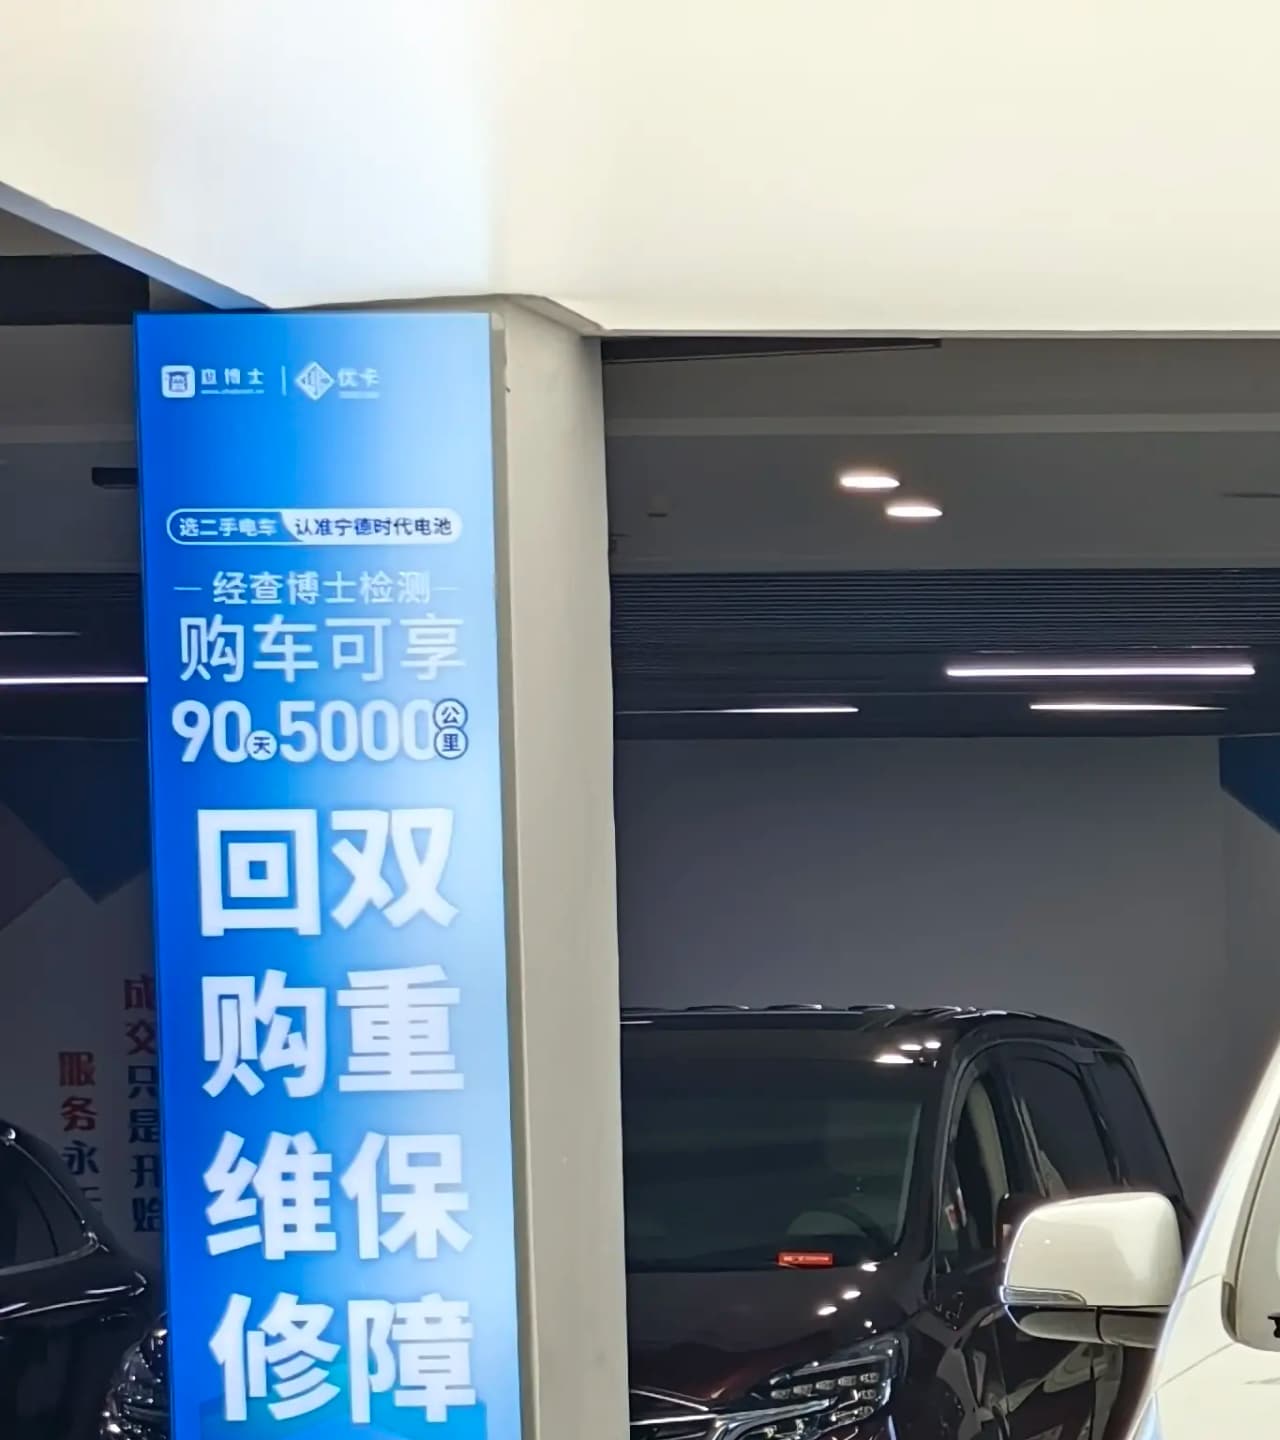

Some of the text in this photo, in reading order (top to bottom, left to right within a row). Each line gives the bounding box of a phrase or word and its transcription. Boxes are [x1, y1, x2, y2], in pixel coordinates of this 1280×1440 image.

[178, 517, 453, 537] 选二手电车 认准宁德时代电池
[212, 570, 431, 606] 经查博士检测
[179, 613, 467, 683] 购车可享
